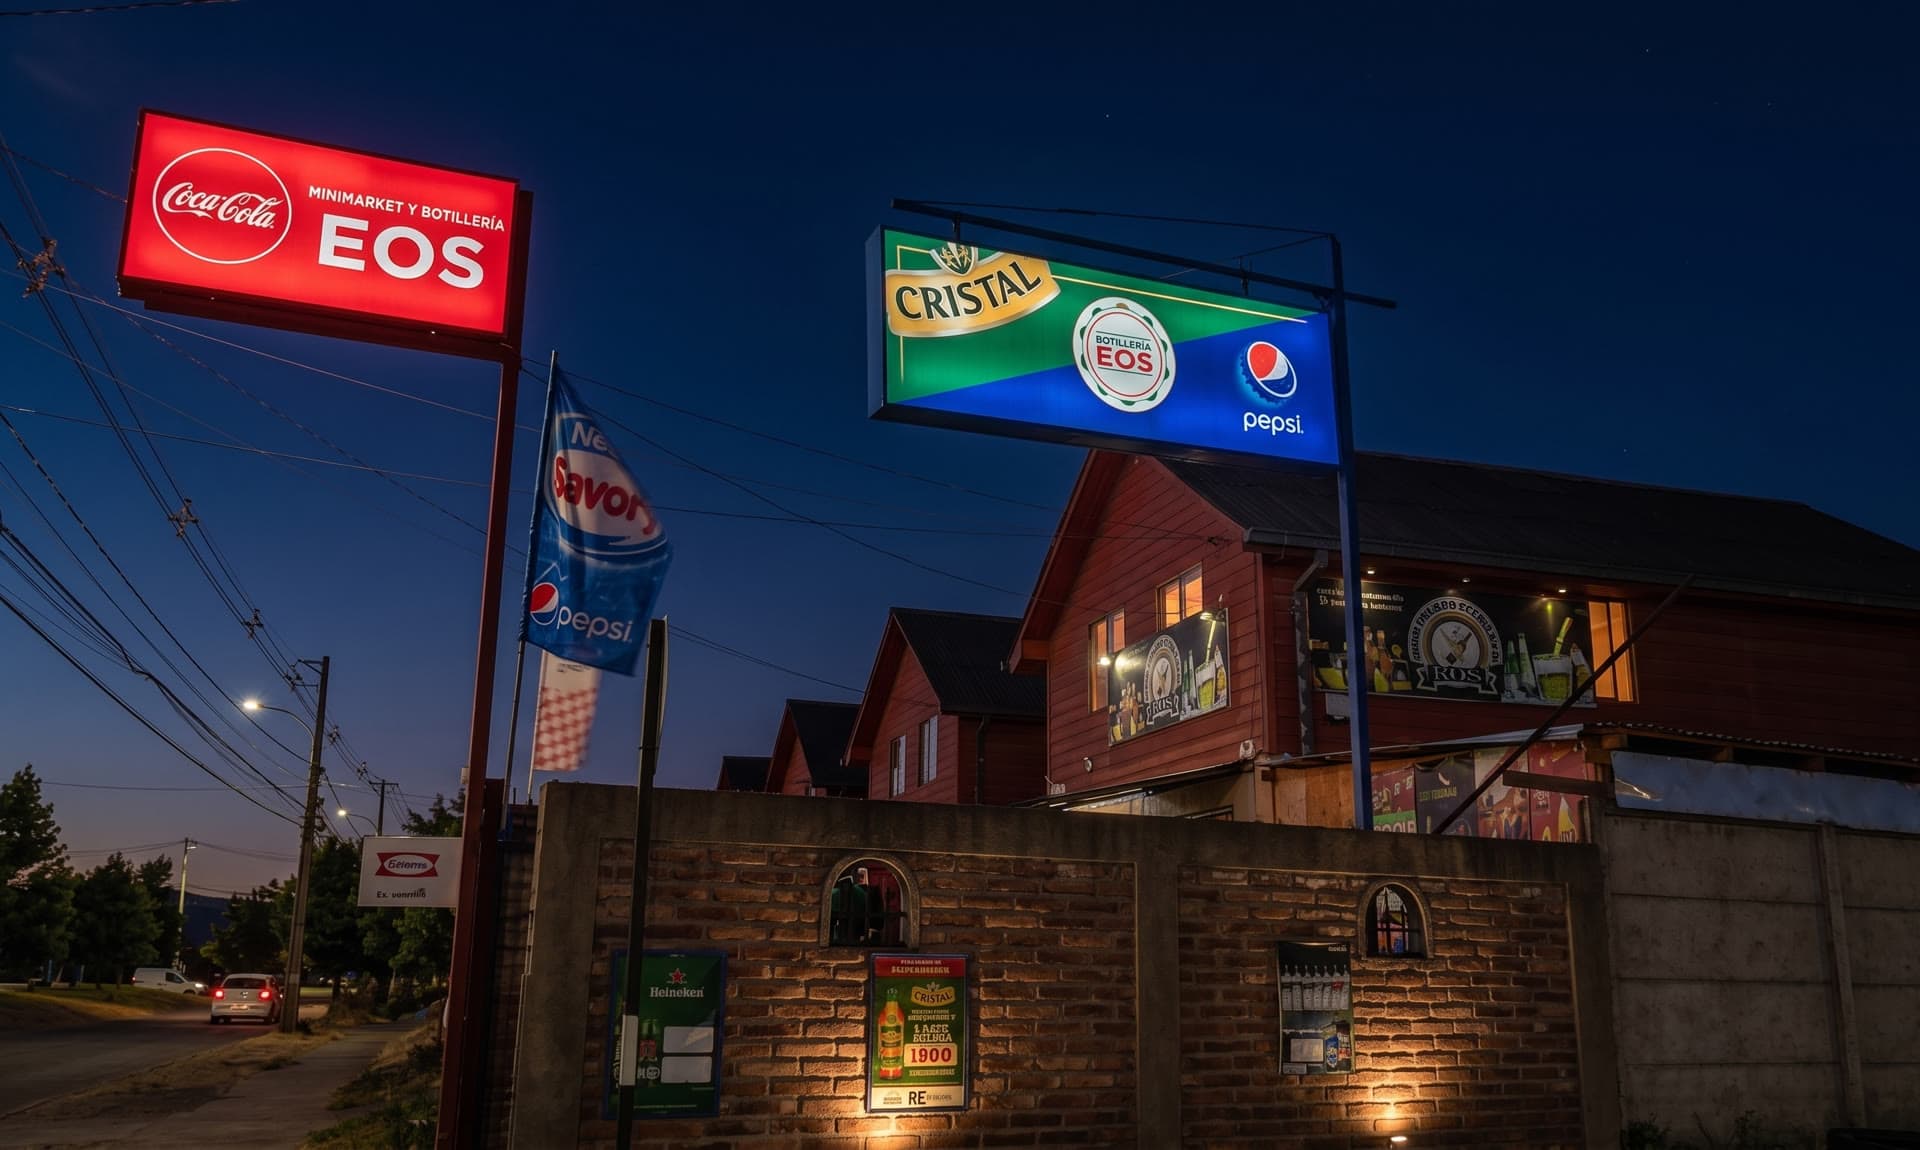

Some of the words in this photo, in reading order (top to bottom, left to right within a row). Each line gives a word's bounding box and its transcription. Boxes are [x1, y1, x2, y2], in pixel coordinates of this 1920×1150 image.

[162, 182, 284, 229] Coca-Cola
[308, 186, 404, 213] MINIMARKET
[407, 203, 418, 215] Y
[421, 206, 505, 231] BOTILLERÍA
[318, 213, 484, 289] EOS
[895, 260, 1043, 322] CRISTAL
[1096, 335, 1152, 351] BOTILLERÍA
[1096, 345, 1153, 373] EOS
[1243, 410, 1303, 434] pepsi
[556, 606, 634, 643] pepsi
[649, 986, 704, 998] Heineken
[914, 991, 953, 1003] CRISTAL
[911, 1047, 952, 1063] 1900
